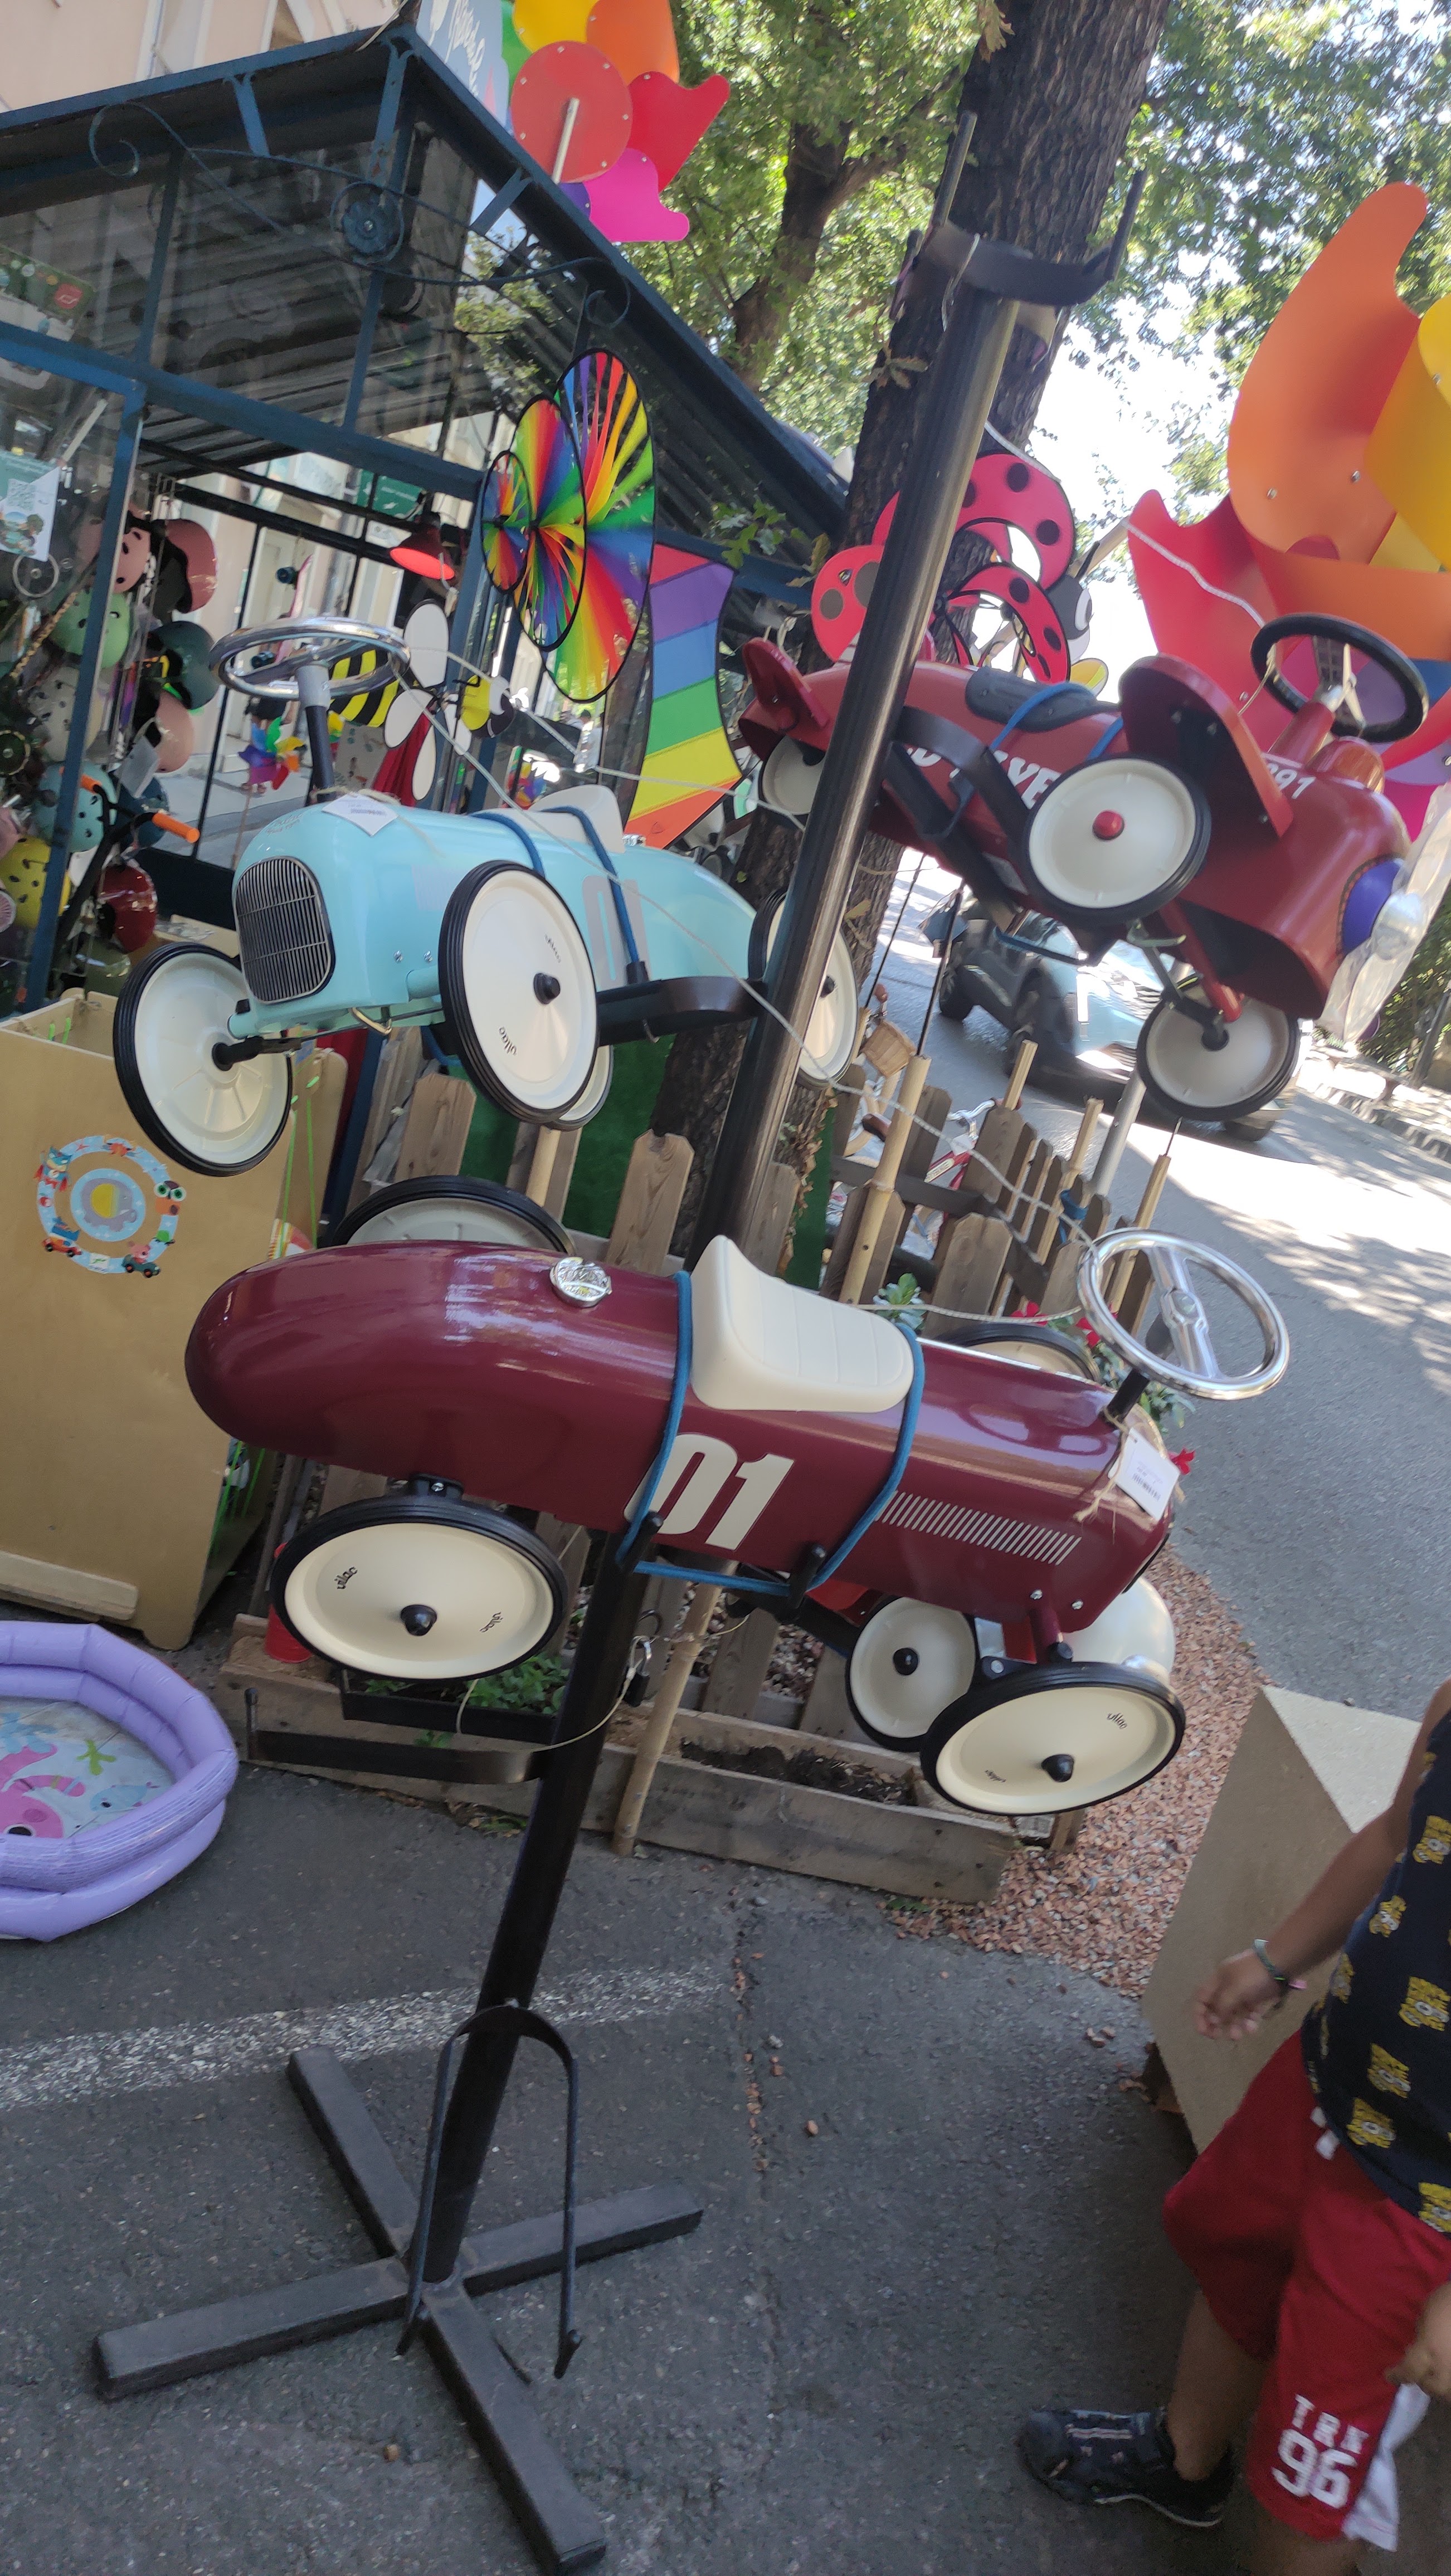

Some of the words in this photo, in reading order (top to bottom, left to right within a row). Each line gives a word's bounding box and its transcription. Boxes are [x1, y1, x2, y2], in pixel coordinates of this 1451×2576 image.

[623, 1433, 795, 1551] 01
[334, 1567, 357, 1589] vilac
[480, 1612, 503, 1633] vilac
[1271, 2428, 1357, 2509] 96
